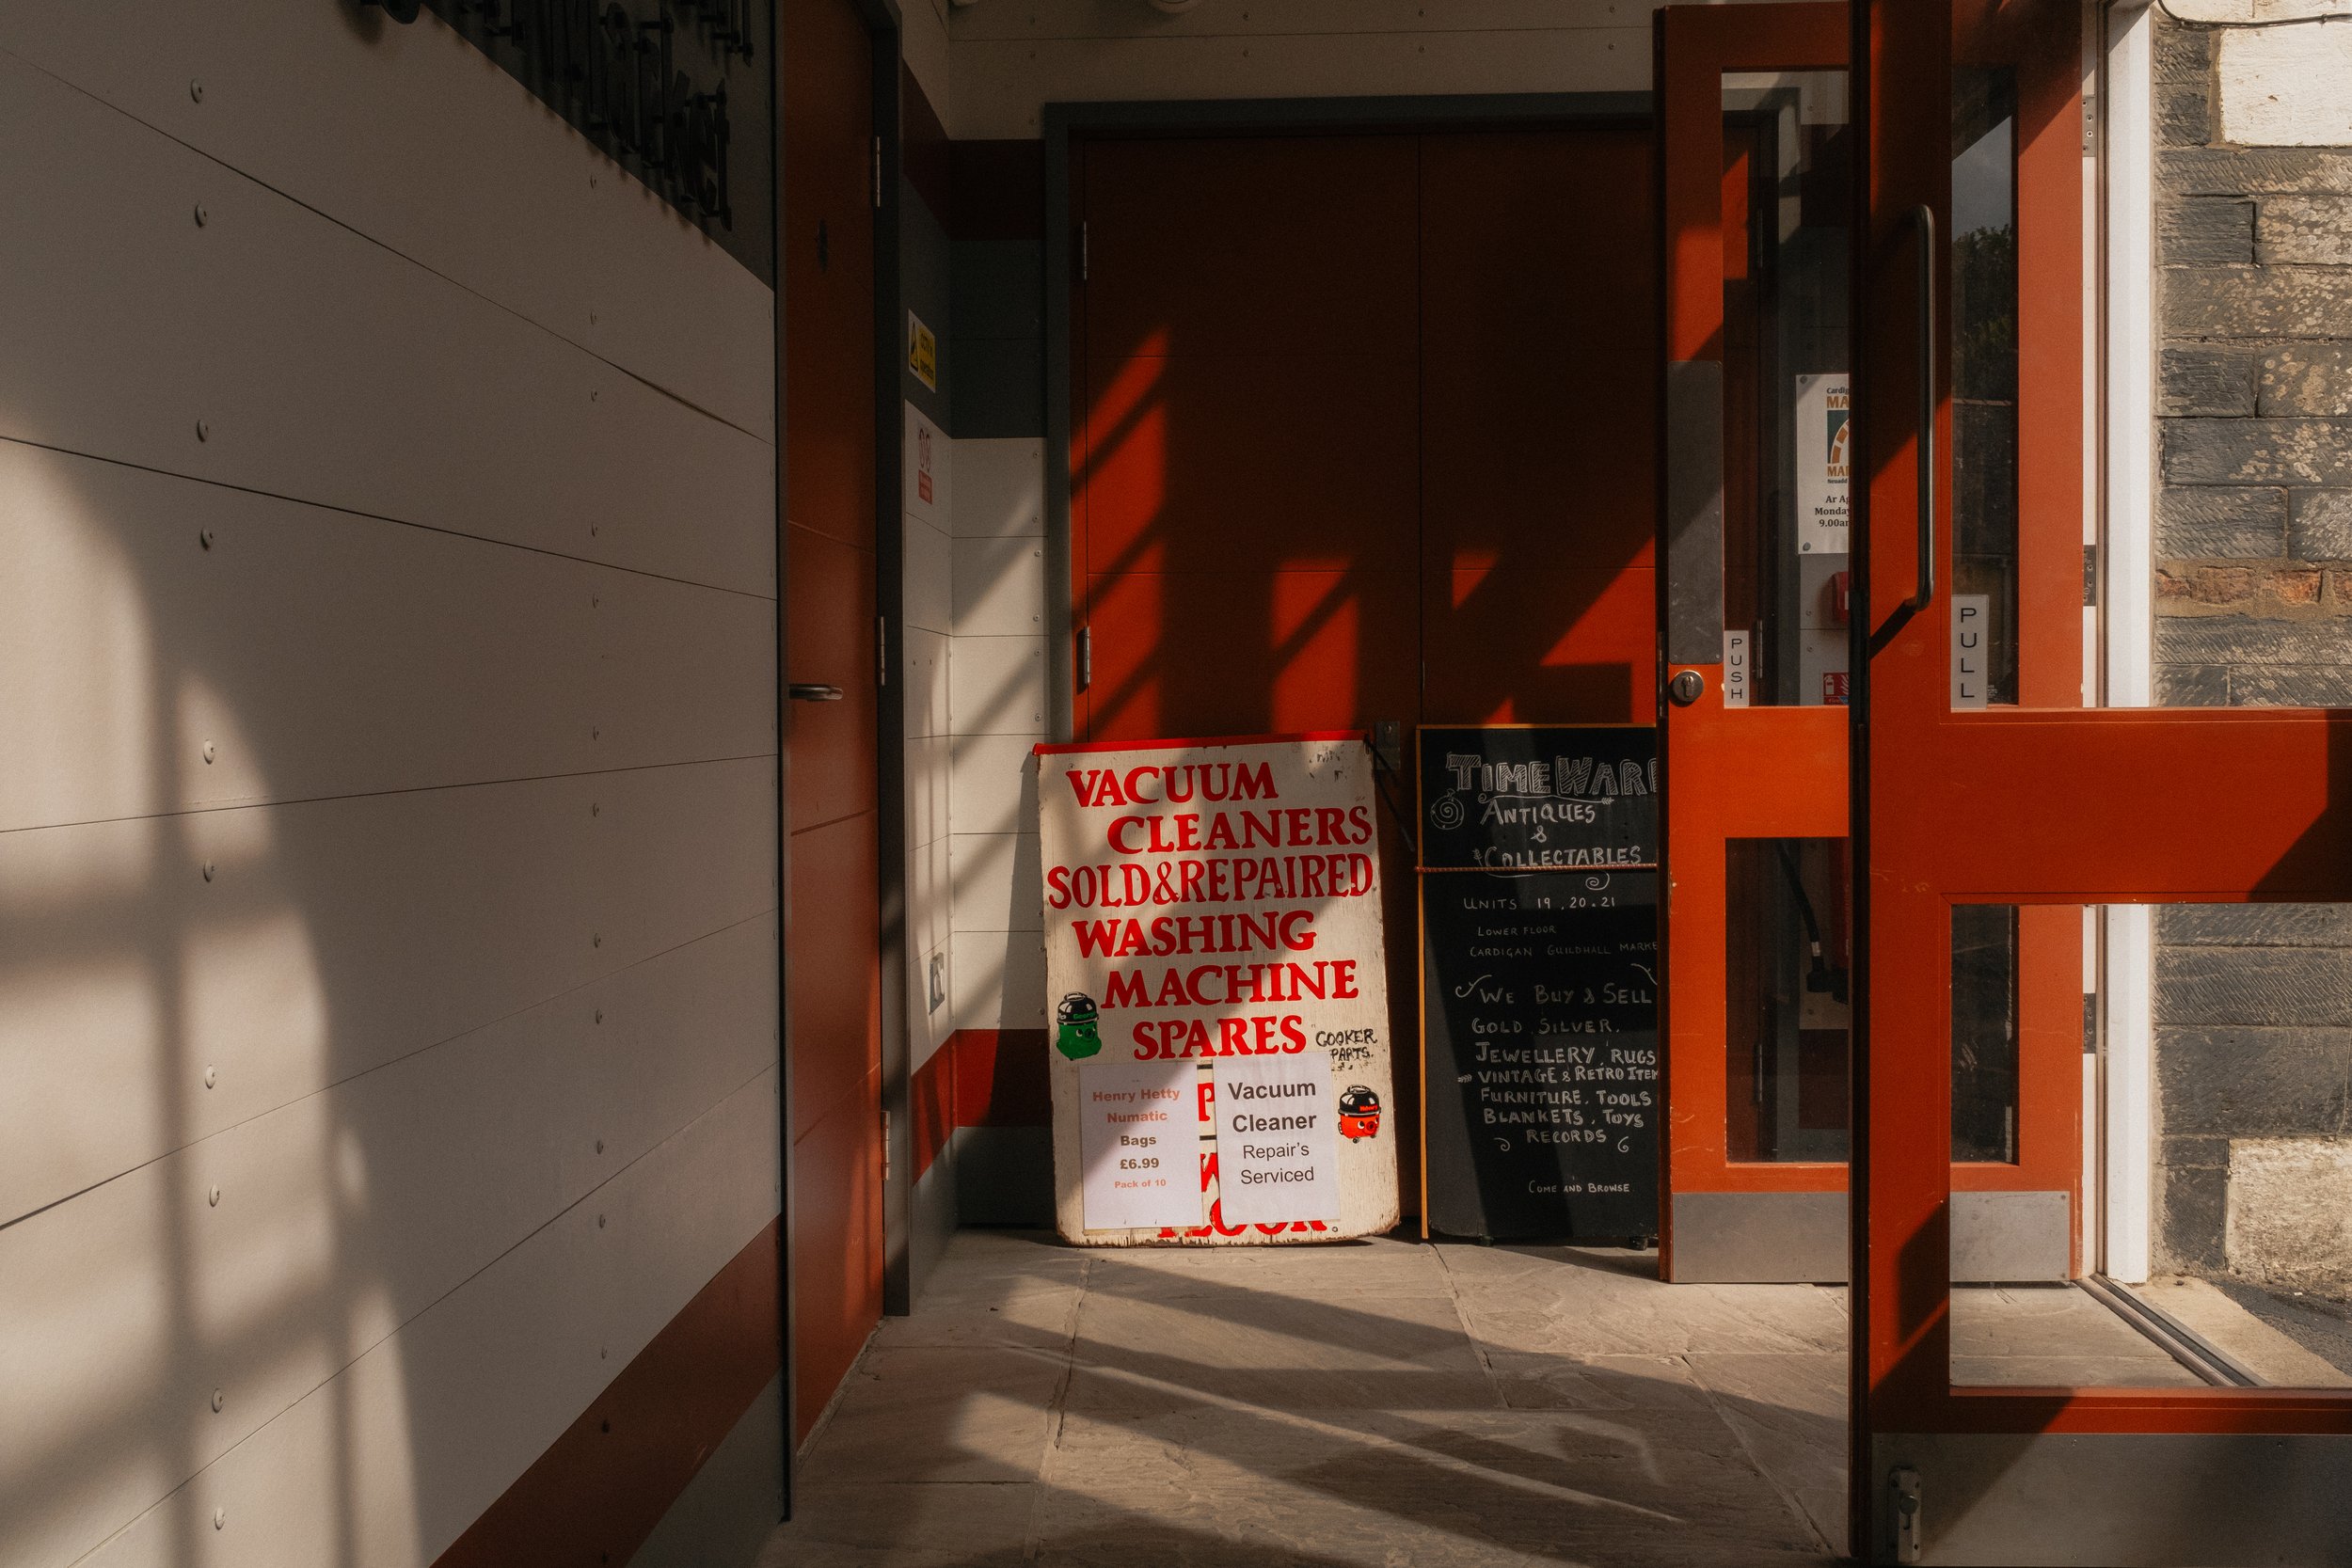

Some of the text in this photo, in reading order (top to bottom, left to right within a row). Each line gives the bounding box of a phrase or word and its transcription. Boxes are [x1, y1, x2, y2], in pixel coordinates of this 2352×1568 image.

[1825, 495, 1837, 503] Ar
[1960, 607, 1978, 699] PULL
[1730, 637, 1743, 700] PUSH
[1065, 761, 1279, 808] VACUUM
[1480, 799, 1597, 825] ANTIQUES
[1106, 806, 1374, 854] CLEANERS
[1484, 845, 1642, 867] COLLECTABLES
[1463, 897, 1518, 911] UNITS
[1071, 910, 1317, 958] WASHING
[1477, 925, 1557, 938] LOWER FLOOR
[1470, 945, 1533, 958] CARDIGAN
[1547, 944, 1612, 957] GUILDHALL
[1100, 959, 1359, 1009] MACHINE
[1480, 987, 1515, 1005] WE
[1534, 984, 1574, 1005] BUY
[1602, 982, 1653, 1005] SELL
[1133, 1014, 1307, 1061] SPARES
[1315, 1028, 1378, 1047] COOKER
[1610, 1048, 1657, 1065] RUGS
[1477, 1068, 1558, 1085] VINTAGE
[1574, 1065, 1625, 1082] RETRO
[1092, 1087, 1181, 1103] Henry Hetty
[1227, 1081, 1316, 1101] Vacuum
[1596, 1089, 1653, 1107] TOOLS
[1106, 1110, 1168, 1123] Numatic
[1232, 1114, 1317, 1133] Cleaner
[1601, 1108, 1645, 1128] TOYS
[1120, 1134, 1157, 1148] Bags
[1525, 1129, 1608, 1145] RECORDS
[1243, 1142, 1310, 1162] Repair's
[1120, 1157, 1160, 1170] £6.99
[1114, 1179, 1167, 1189] Pack of 10
[1240, 1166, 1314, 1185] Serviced
[1528, 1180, 1630, 1194] COME AND BROWSE
